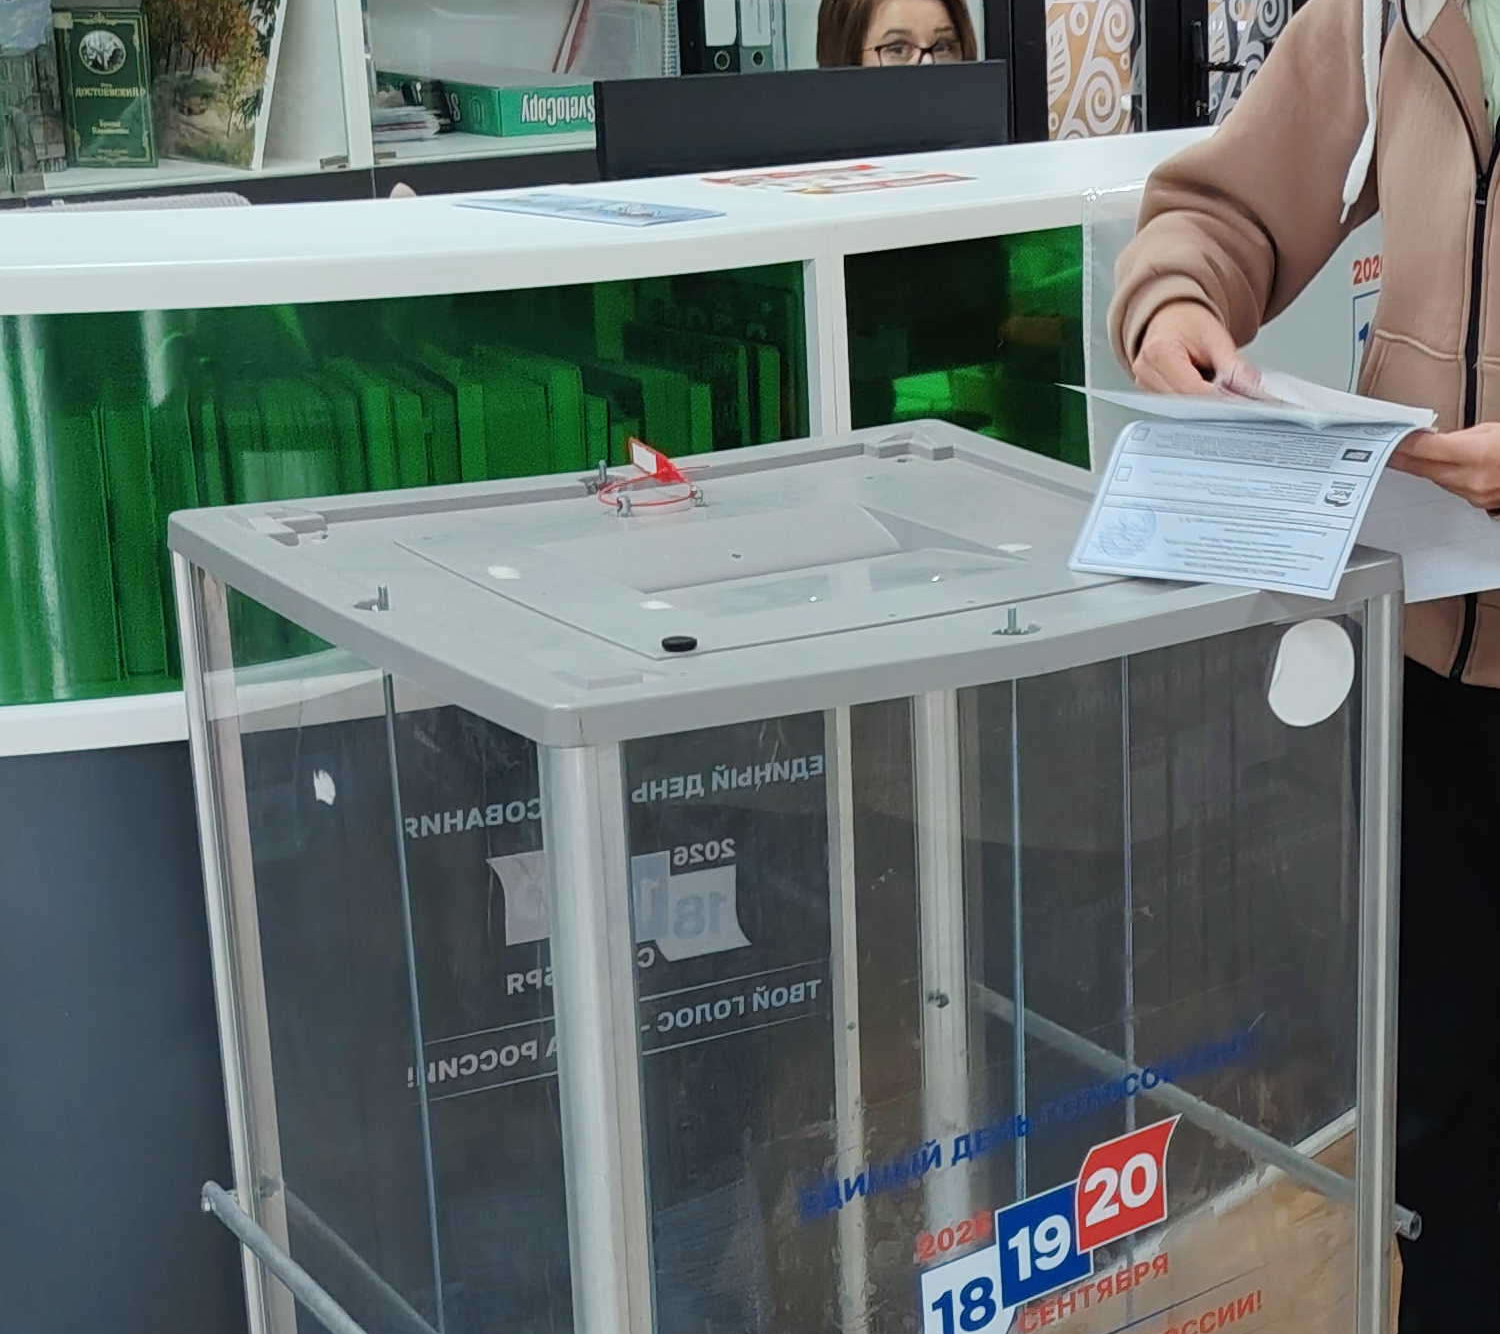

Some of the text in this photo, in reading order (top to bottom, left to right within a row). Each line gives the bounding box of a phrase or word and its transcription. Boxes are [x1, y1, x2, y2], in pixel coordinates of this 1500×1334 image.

[521, 93, 595, 125] SvetoCopy
[1352, 254, 1384, 286] 202
[1084, 1153, 1158, 1228] 20
[1007, 1213, 1071, 1281] 19
[1017, 1252, 1169, 1334] СЕНТЯБРЯ
